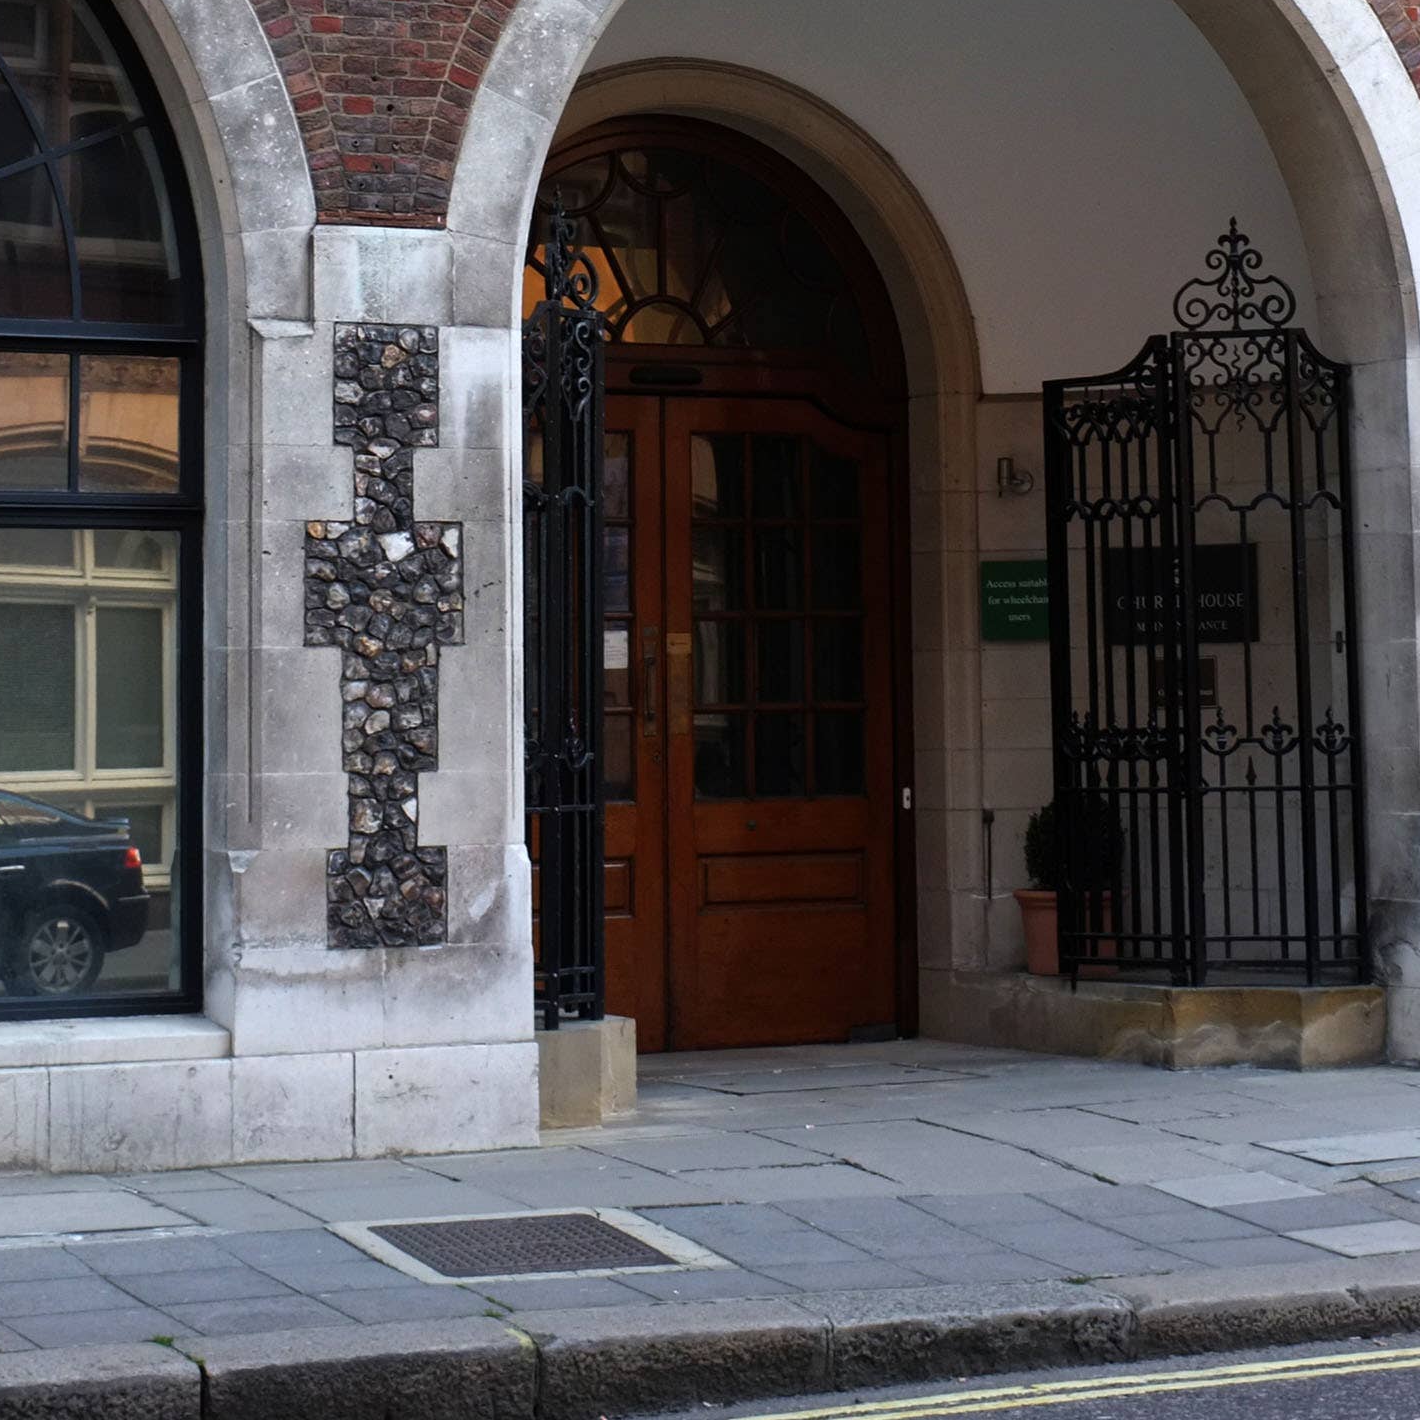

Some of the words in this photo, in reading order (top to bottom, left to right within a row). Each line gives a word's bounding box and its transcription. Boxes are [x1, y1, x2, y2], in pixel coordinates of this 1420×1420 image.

[986, 579, 1016, 588] Access
[1018, 578, 1048, 588] suitabl
[988, 595, 1000, 605] for
[1116, 594, 1185, 610] CHUR
